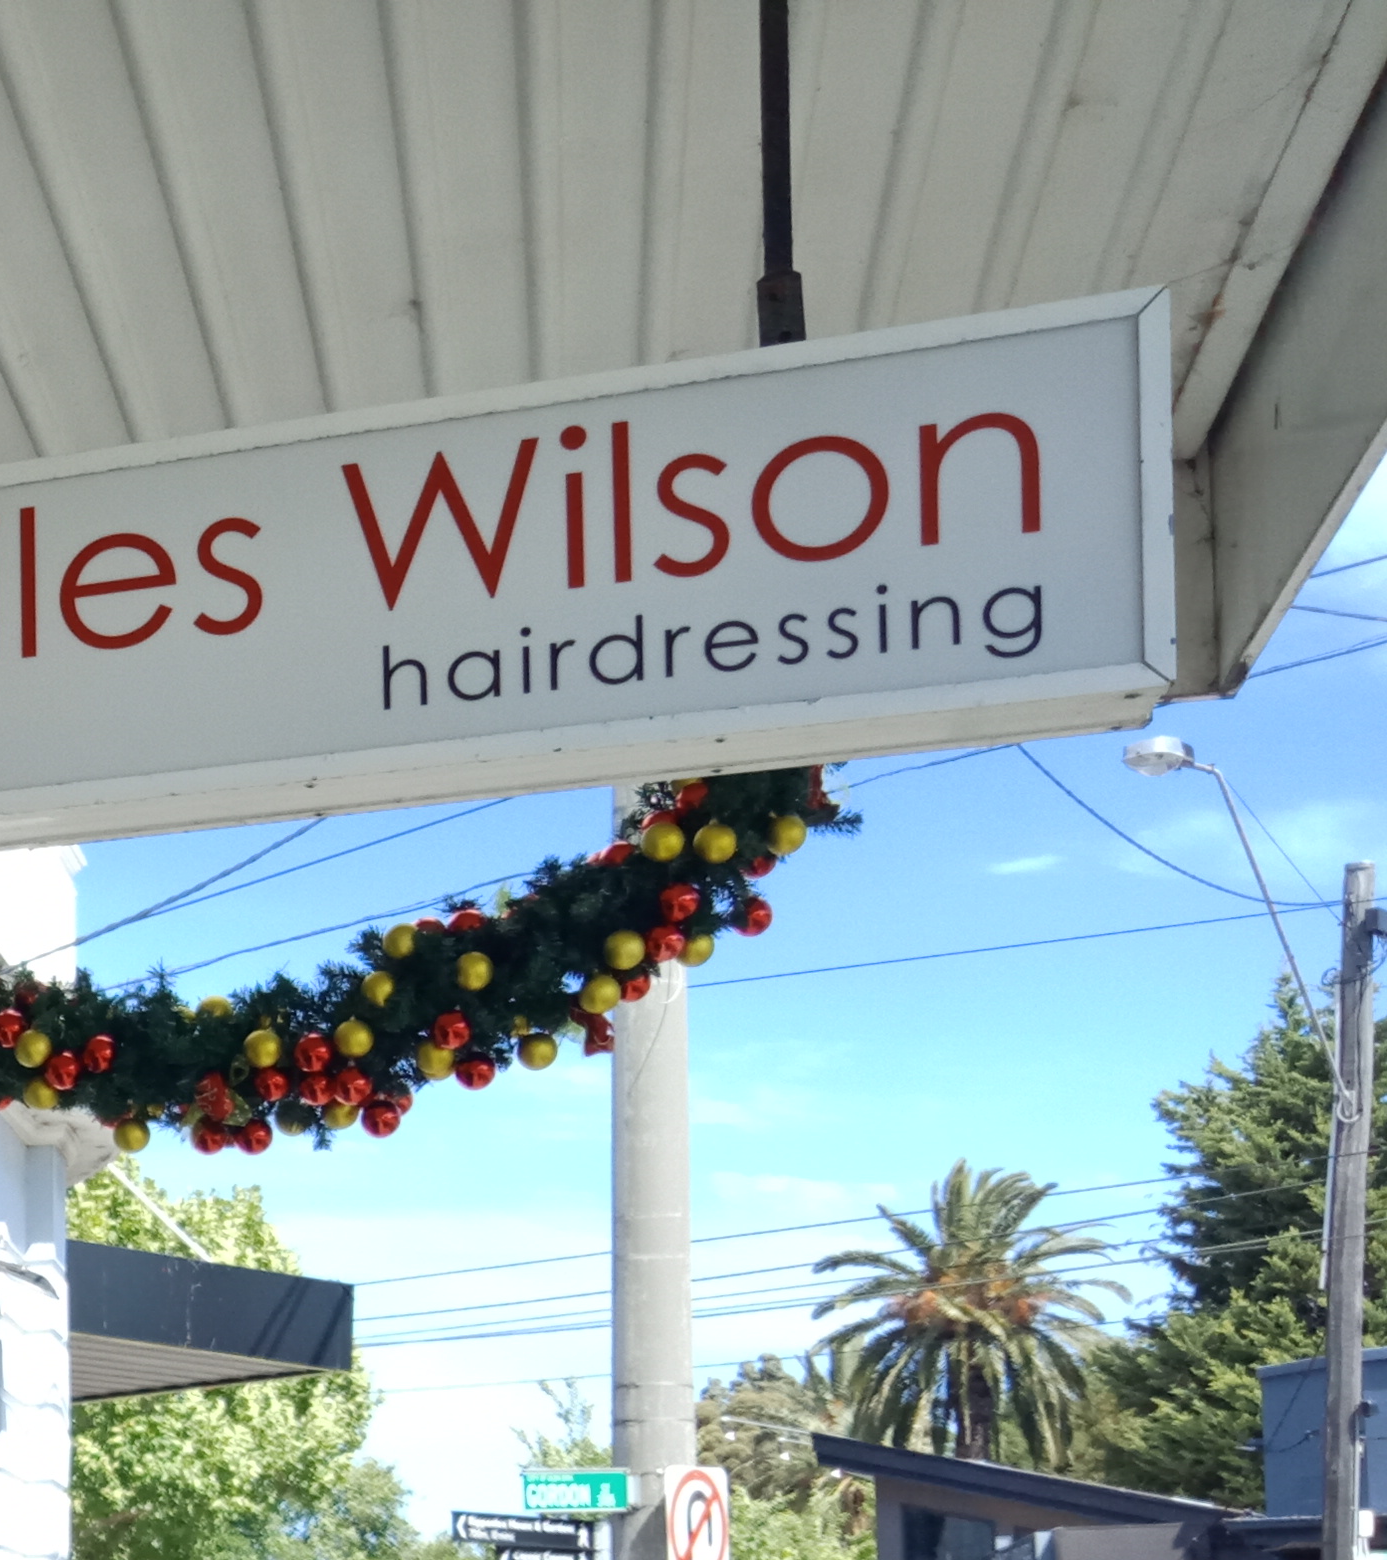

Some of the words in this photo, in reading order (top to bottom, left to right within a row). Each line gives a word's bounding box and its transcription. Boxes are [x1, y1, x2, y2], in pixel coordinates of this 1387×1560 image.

[340, 408, 1042, 614] Wilson
[382, 577, 1047, 713] hairdressing
[526, 1482, 592, 1508] GORDON
